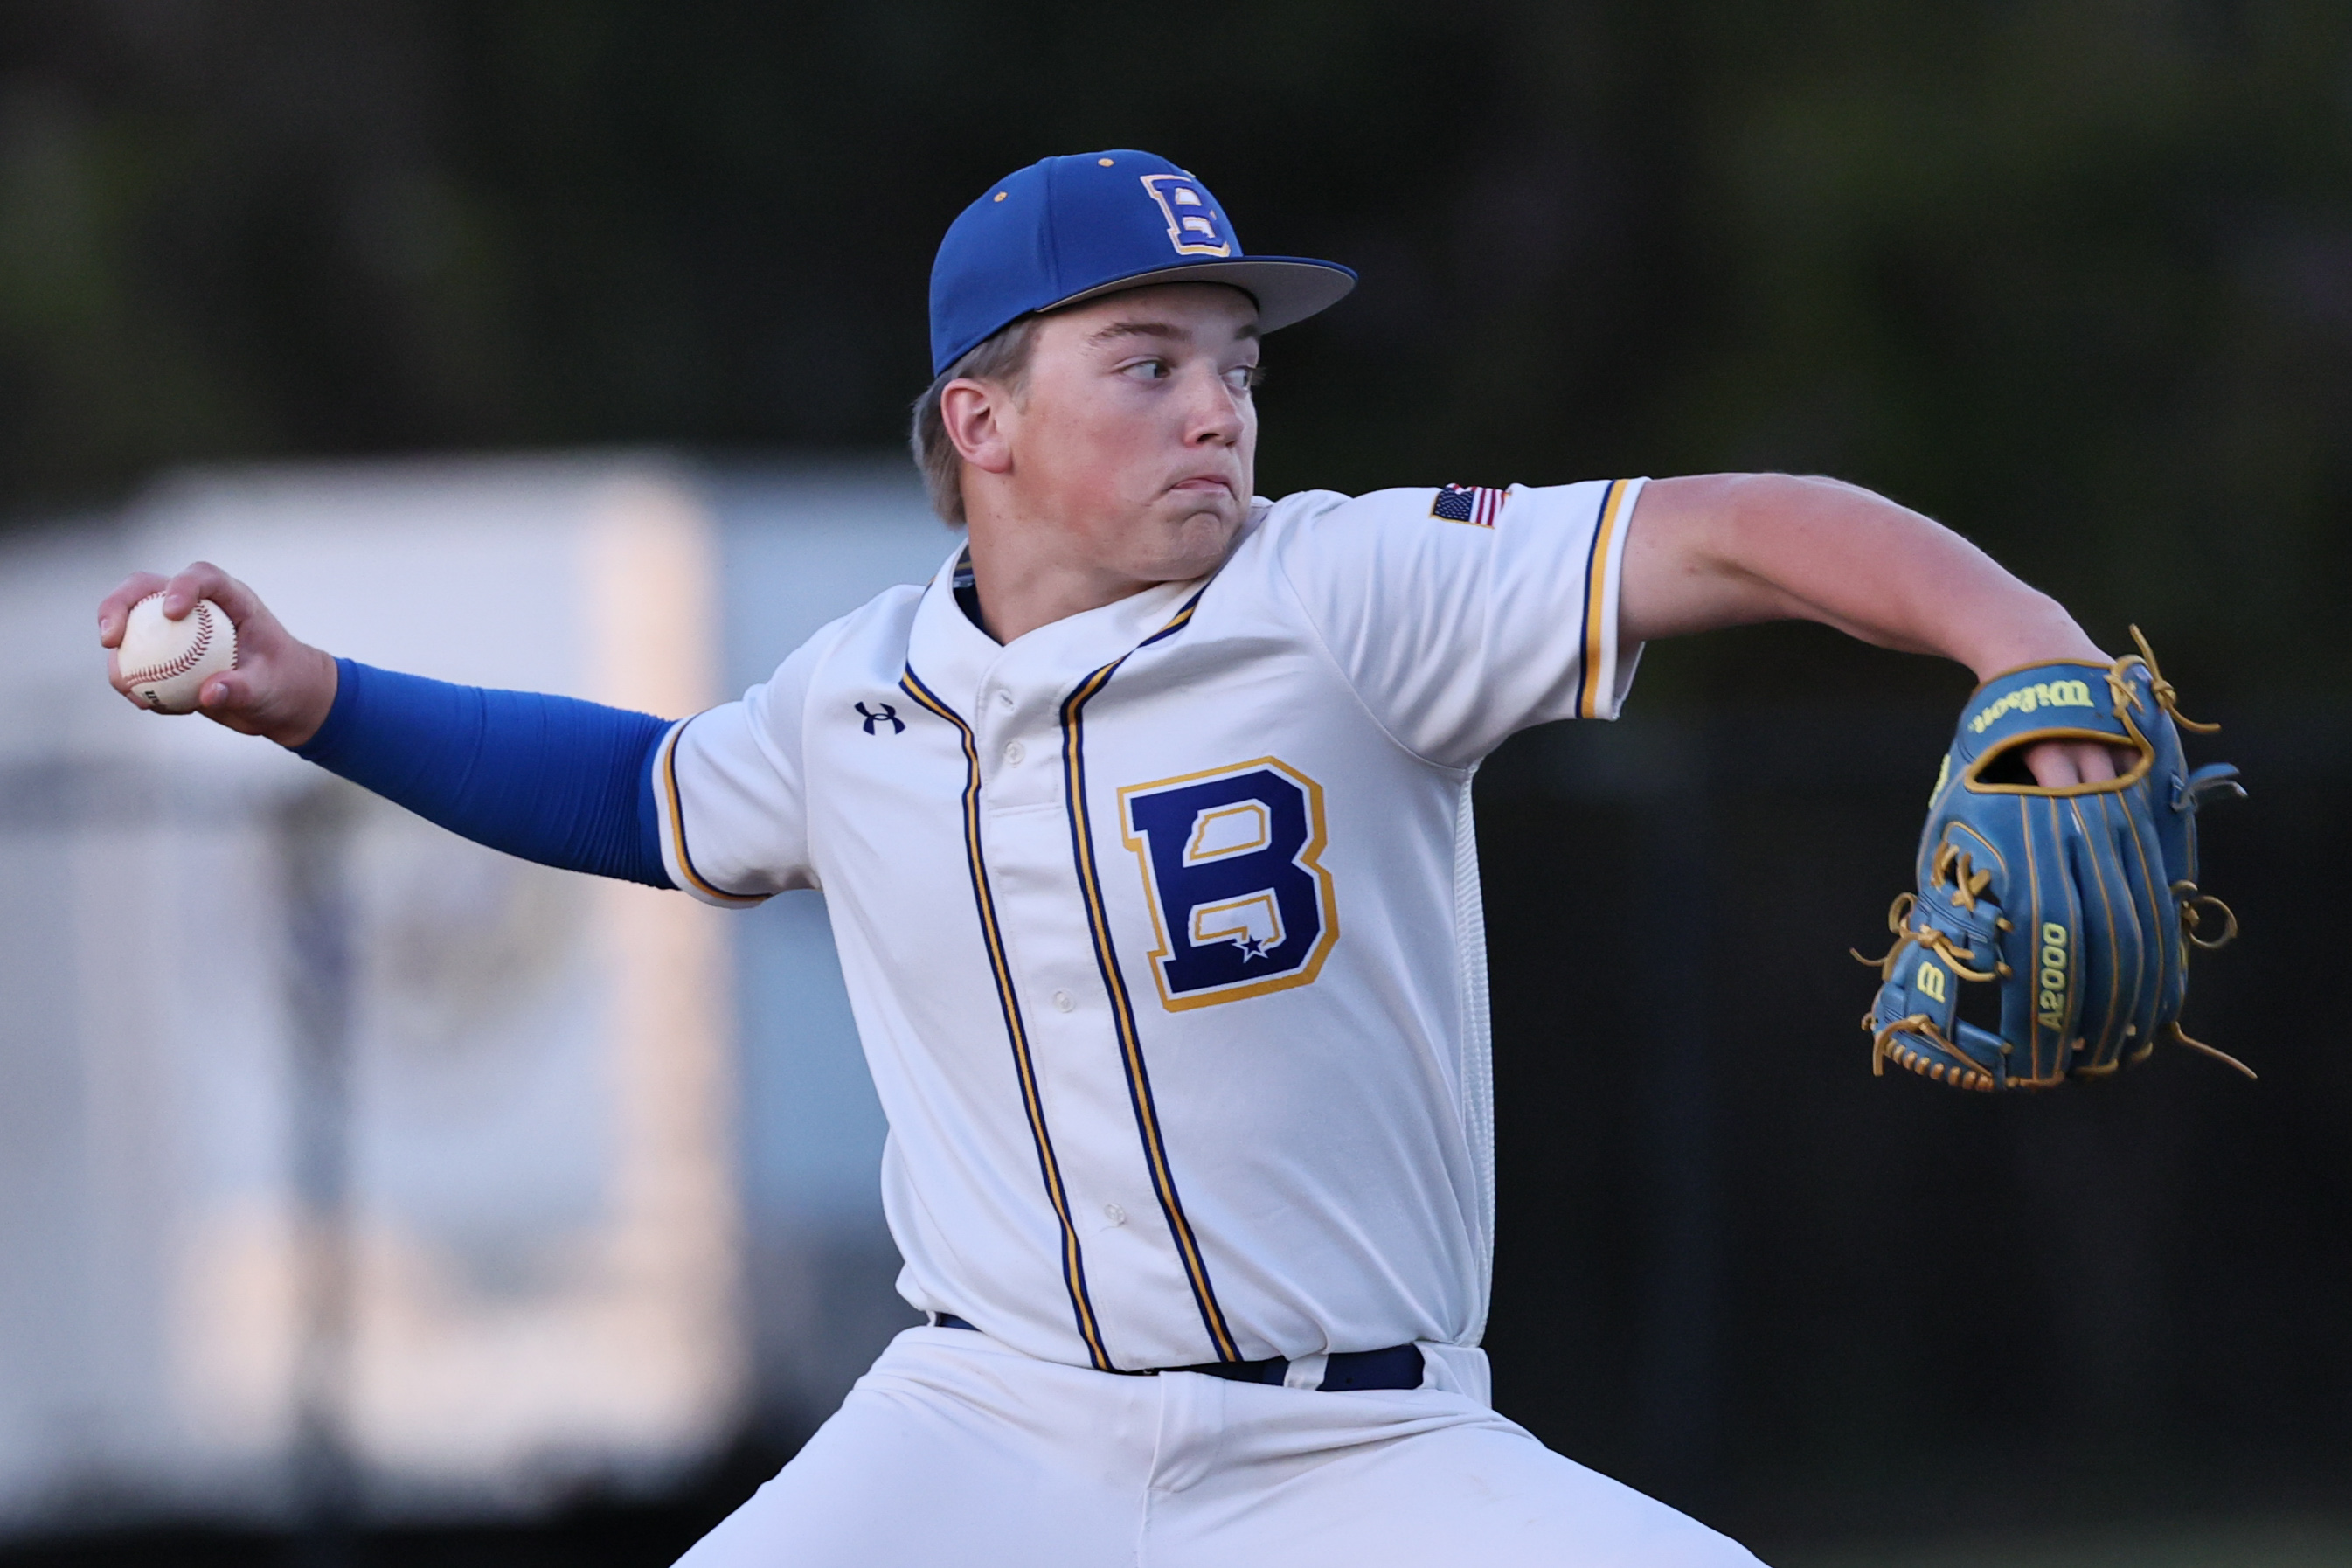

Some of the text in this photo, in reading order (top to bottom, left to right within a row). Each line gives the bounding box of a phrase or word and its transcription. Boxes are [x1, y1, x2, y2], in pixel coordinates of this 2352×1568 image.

[1141, 174, 1231, 256] B
[1973, 680, 2095, 733] Wilson
[1117, 755, 1340, 1013] B
[2037, 923, 2069, 1032] A2000
